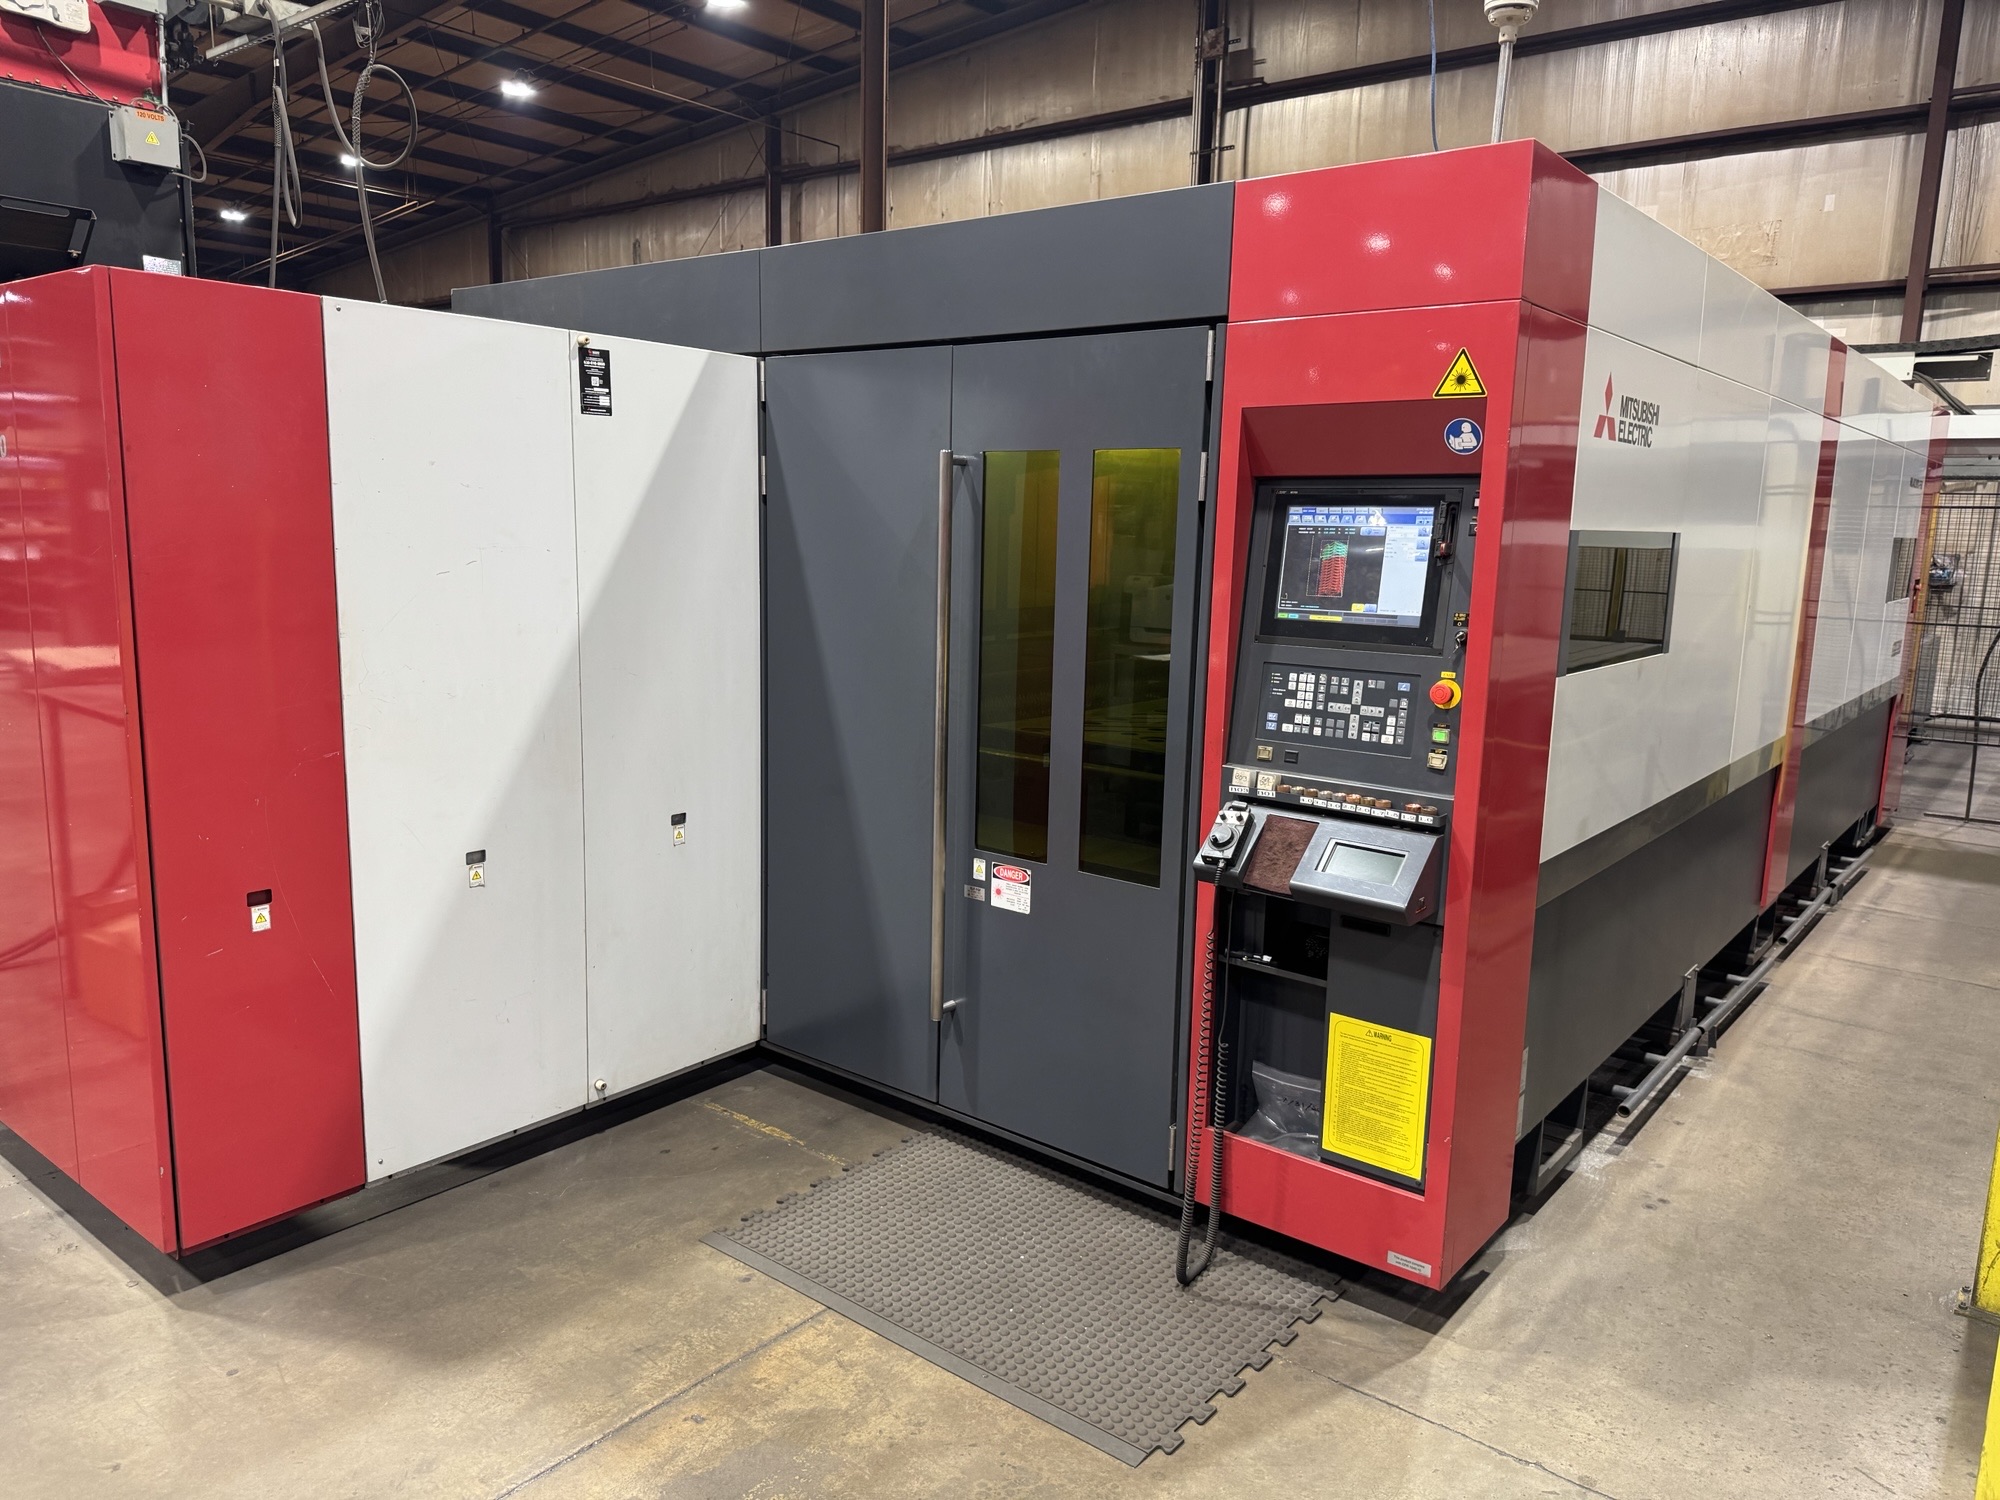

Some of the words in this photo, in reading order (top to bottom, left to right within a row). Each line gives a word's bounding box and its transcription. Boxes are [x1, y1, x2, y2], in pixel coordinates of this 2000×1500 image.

[147, 113, 165, 121] VOLTS
[1620, 395, 1660, 425] MITSUBISHI
[1618, 420, 1653, 448] ELECTRIC
[999, 868, 1023, 881] DANGER
[1373, 1031, 1392, 1042] WARNING
